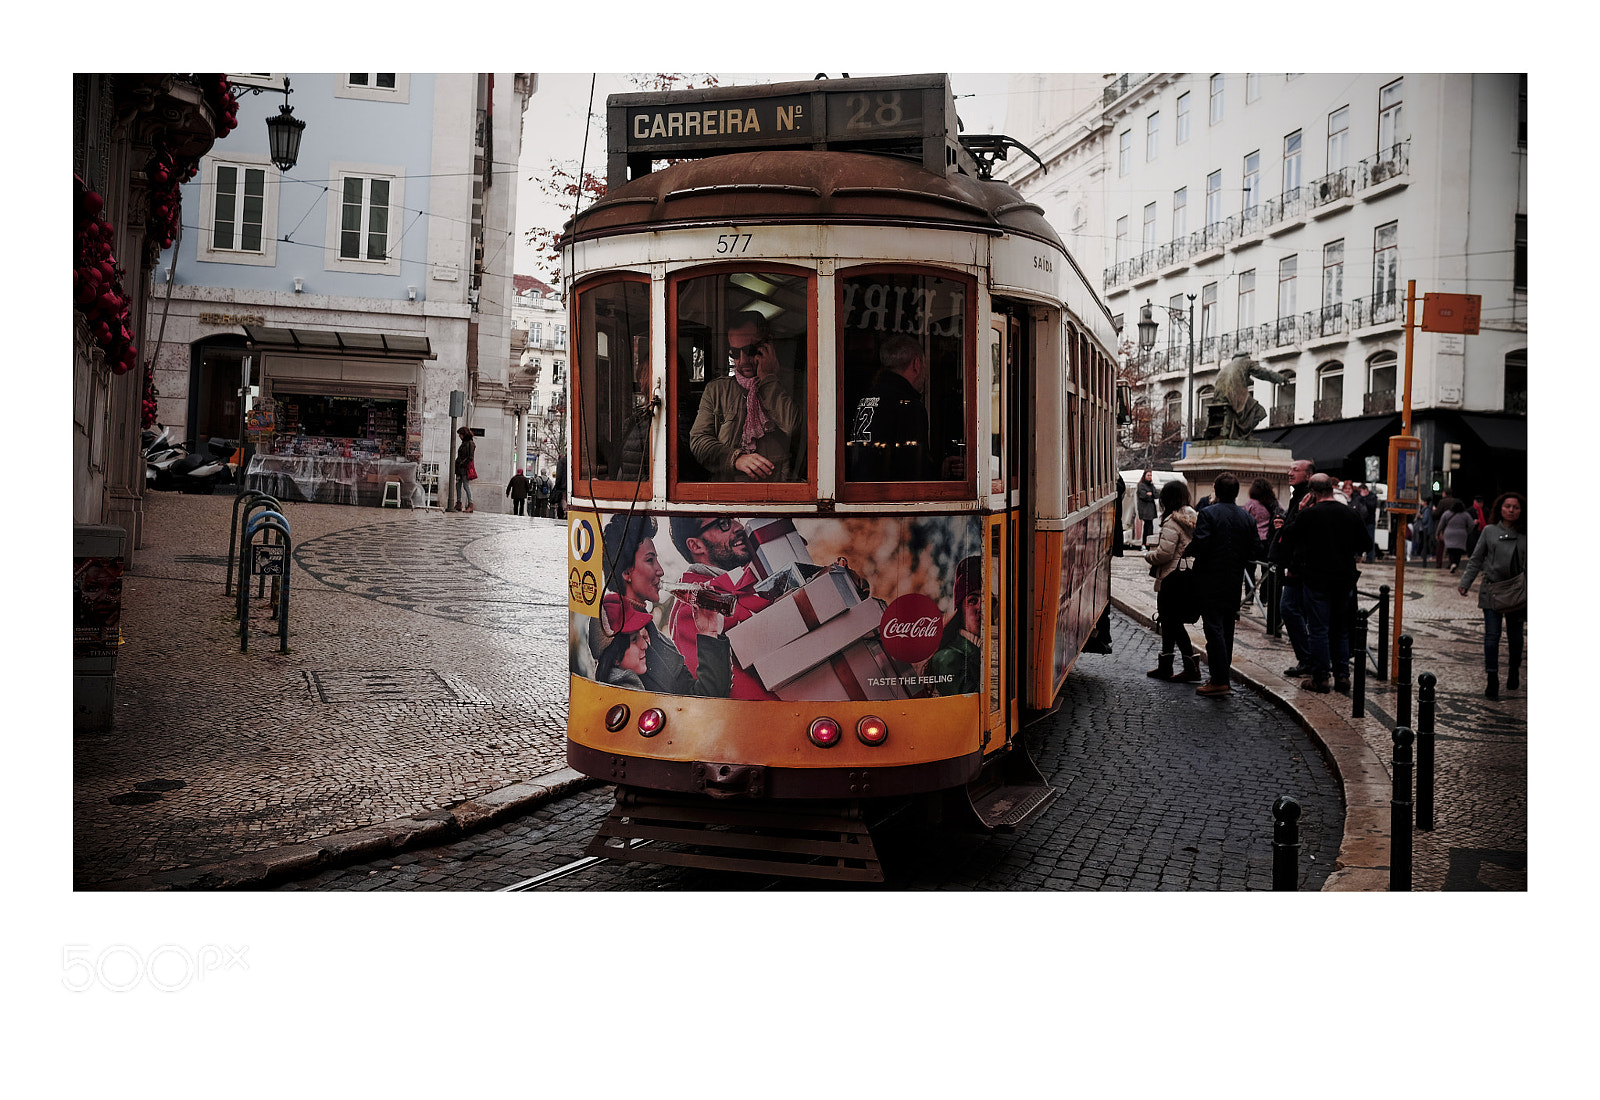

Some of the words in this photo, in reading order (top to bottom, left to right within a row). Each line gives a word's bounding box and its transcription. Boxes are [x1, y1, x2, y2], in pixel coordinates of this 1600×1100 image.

[633, 108, 761, 139] CARREIRA
[845, 91, 904, 130] 28
[716, 233, 753, 254] 577
[883, 616, 941, 640] Coca-Cola
[867, 677, 897, 687] TASTE
[899, 676, 917, 686] THE
[918, 674, 955, 685] FEELING
